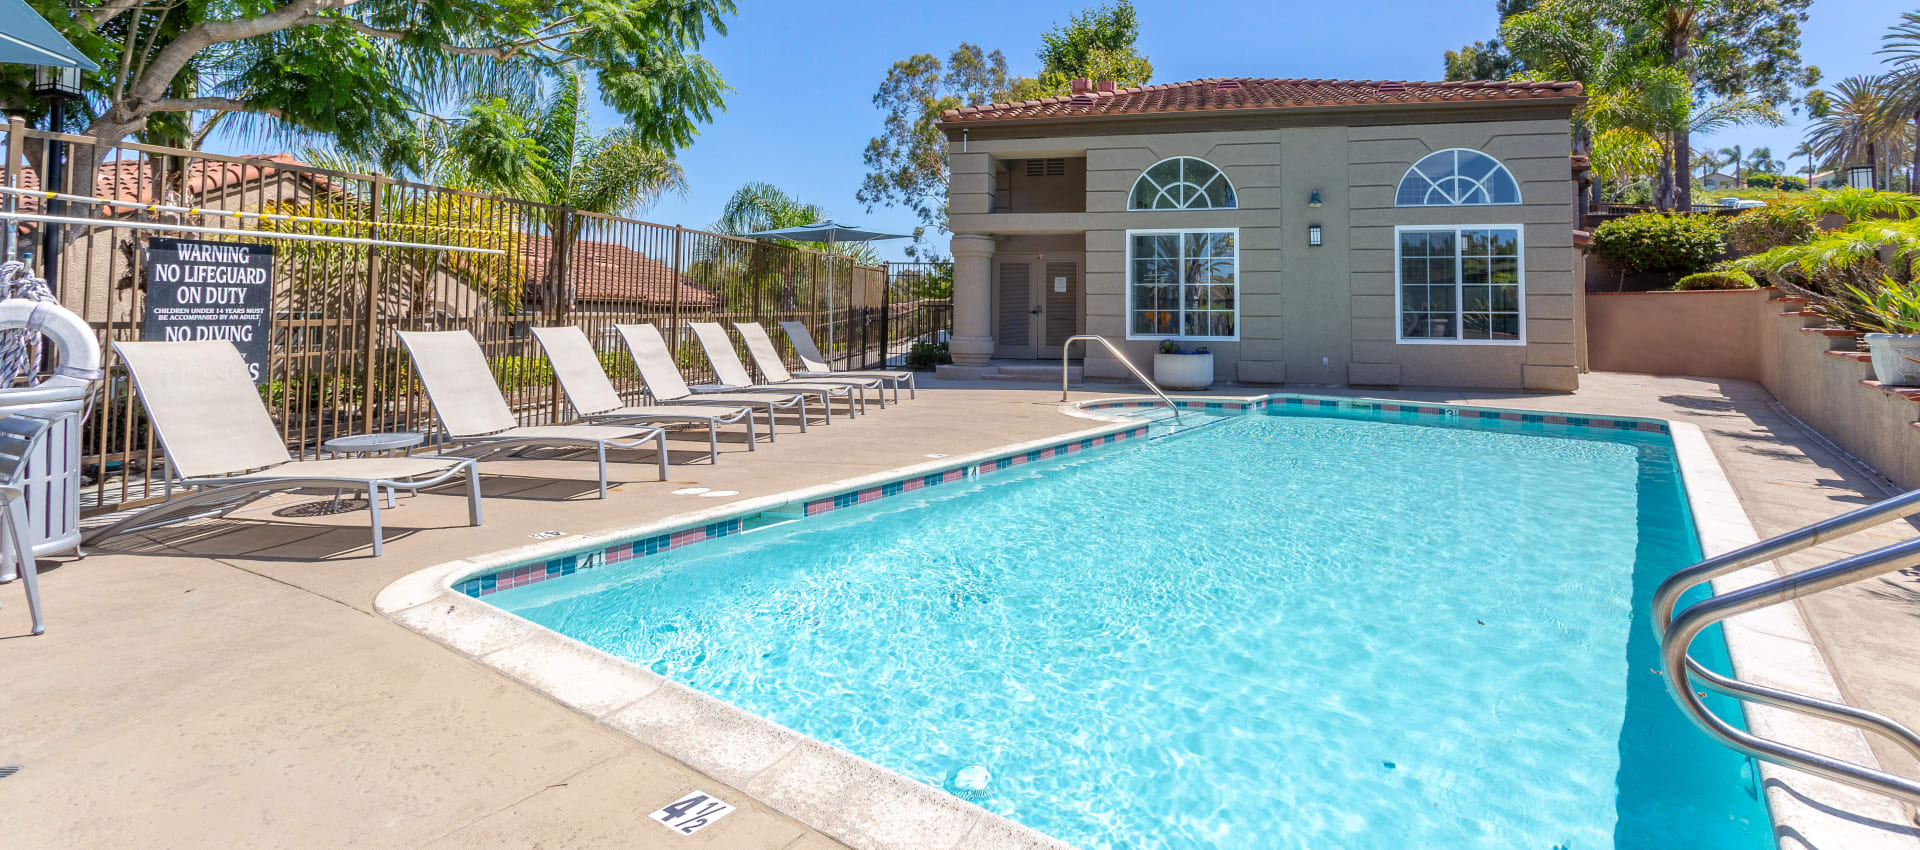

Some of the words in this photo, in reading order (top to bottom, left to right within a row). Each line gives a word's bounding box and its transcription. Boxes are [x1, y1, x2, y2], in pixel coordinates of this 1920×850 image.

[176, 243, 250, 263] WARNING
[155, 264, 180, 282] NO
[184, 265, 266, 284] LIFEGUARD
[177, 286, 201, 304] ON
[206, 287, 247, 304] DUTY
[165, 326, 192, 342] NO
[196, 325, 253, 342] DIVING
